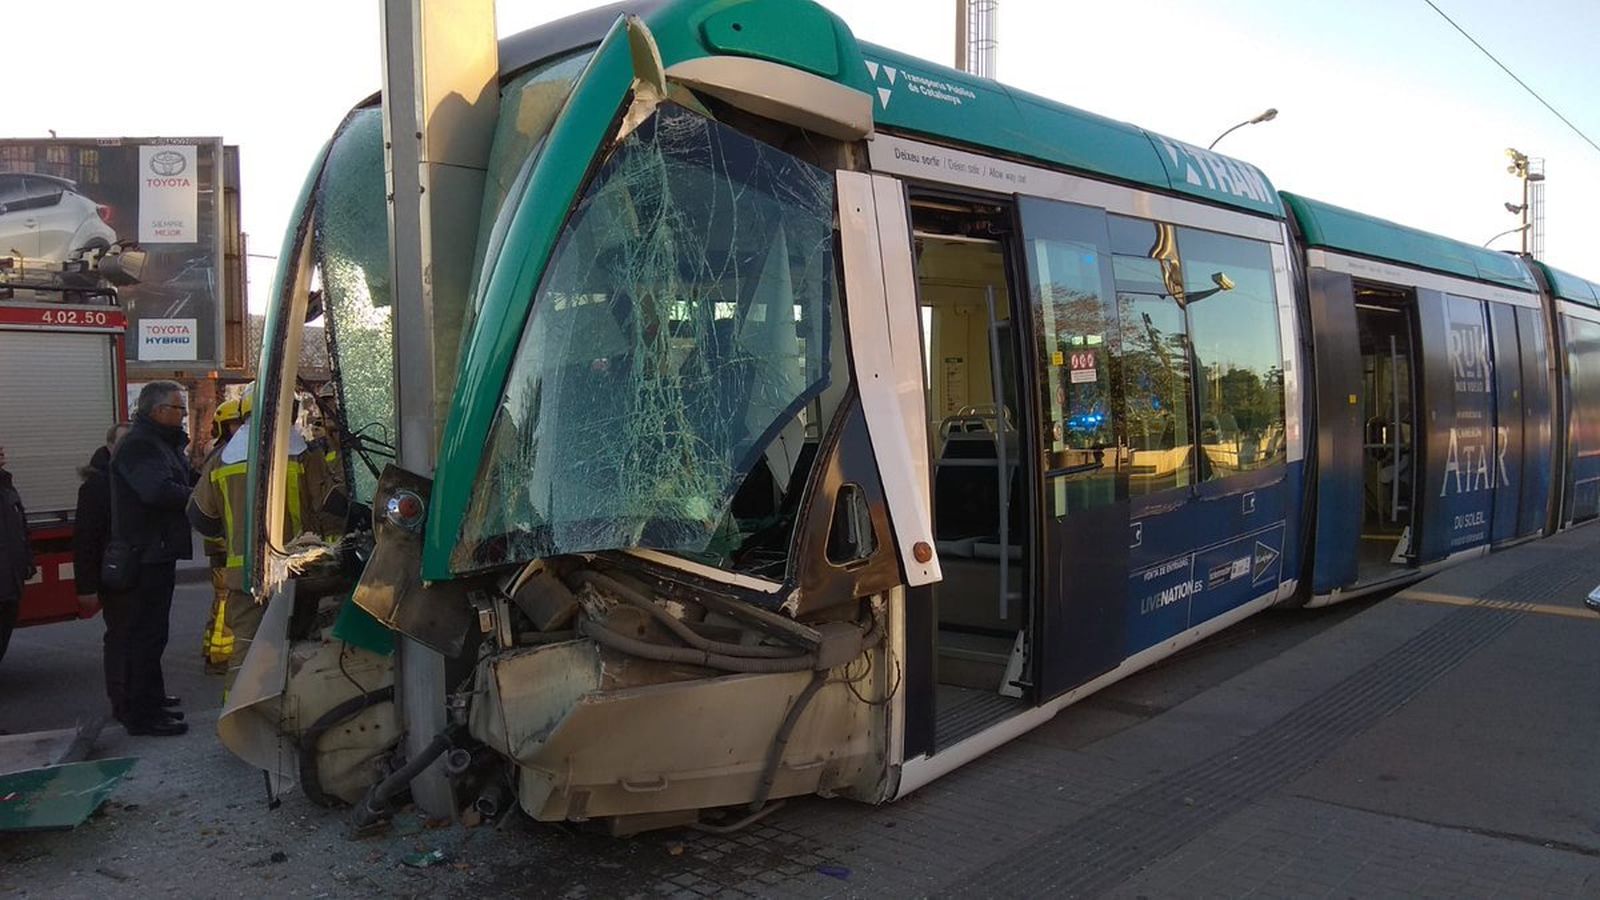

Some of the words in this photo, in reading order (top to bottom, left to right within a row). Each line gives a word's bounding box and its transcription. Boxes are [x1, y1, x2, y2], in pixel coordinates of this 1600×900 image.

[146, 178, 191, 188] TOYOTA
[42, 311, 106, 325] 4.02.50
[146, 325, 190, 335] TOYOTA
[146, 336, 190, 345] HYBRID
[1440, 426, 1510, 497] ATAR
